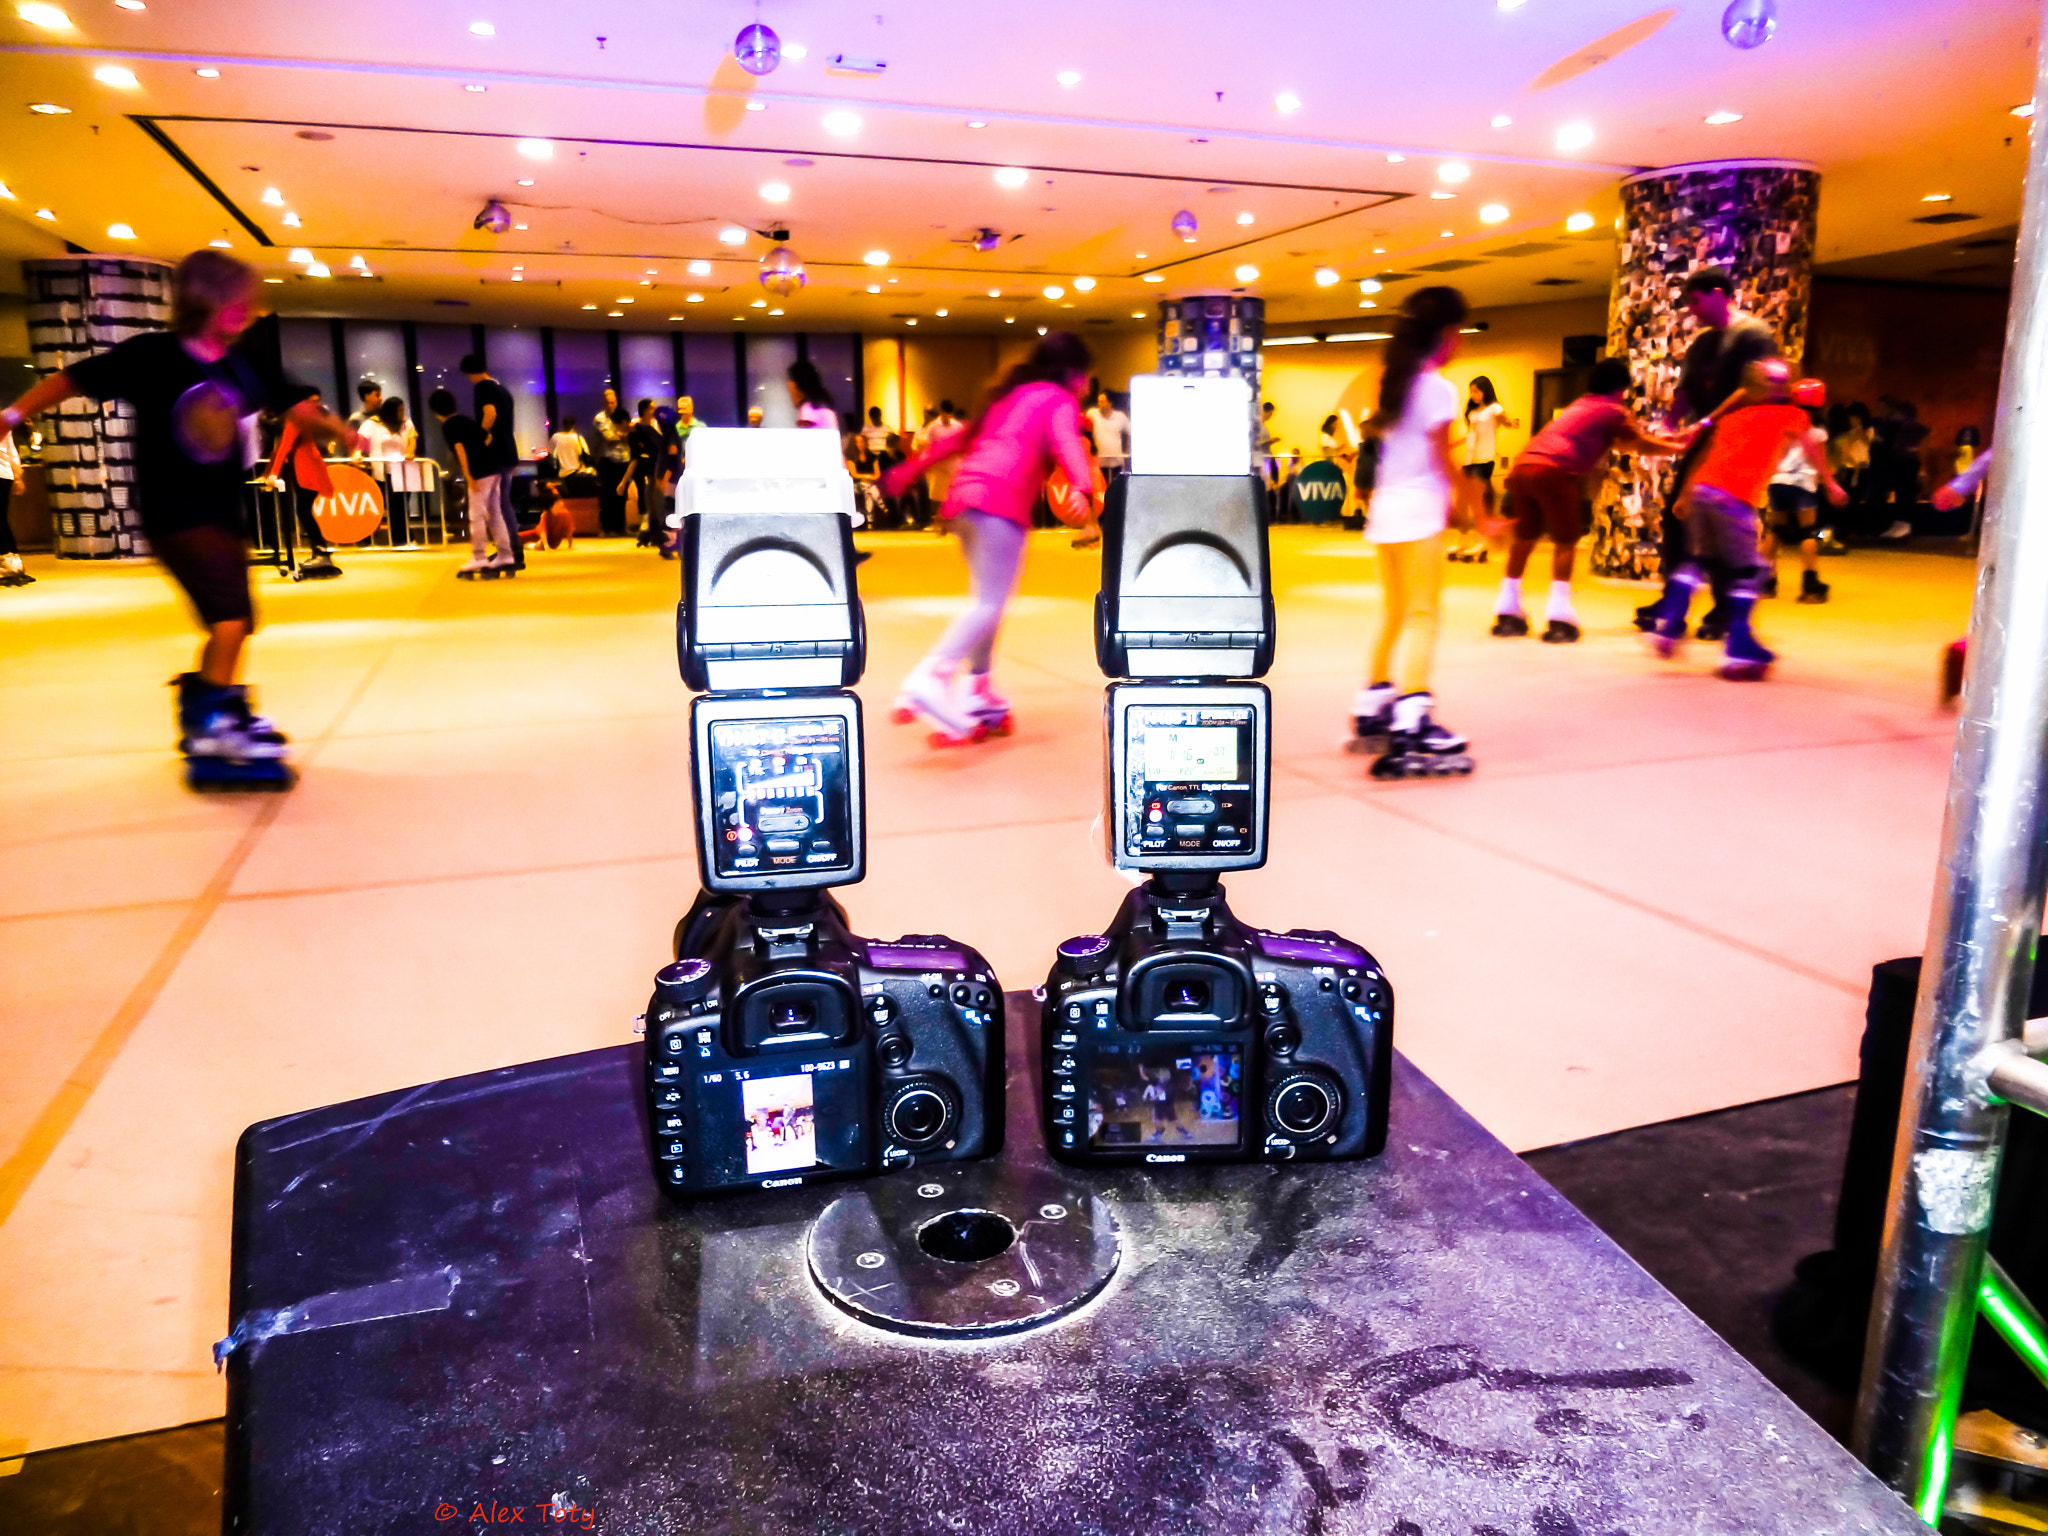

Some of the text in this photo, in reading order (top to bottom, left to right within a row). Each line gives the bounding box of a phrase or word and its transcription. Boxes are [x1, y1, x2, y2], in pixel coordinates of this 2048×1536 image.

[1297, 481, 1343, 501] VIVA
[313, 492, 379, 516] VIVA
[1169, 734, 1177, 742] M
[1143, 840, 1166, 848] PILOT
[1212, 839, 1241, 848] ON/OFF
[771, 856, 798, 865] MODE
[659, 999, 719, 1021] OFF ON
[703, 1073, 723, 1083] 1/60
[735, 1071, 750, 1080] 5.6
[1145, 1153, 1186, 1163] Canon
[761, 1177, 803, 1189] Canon
